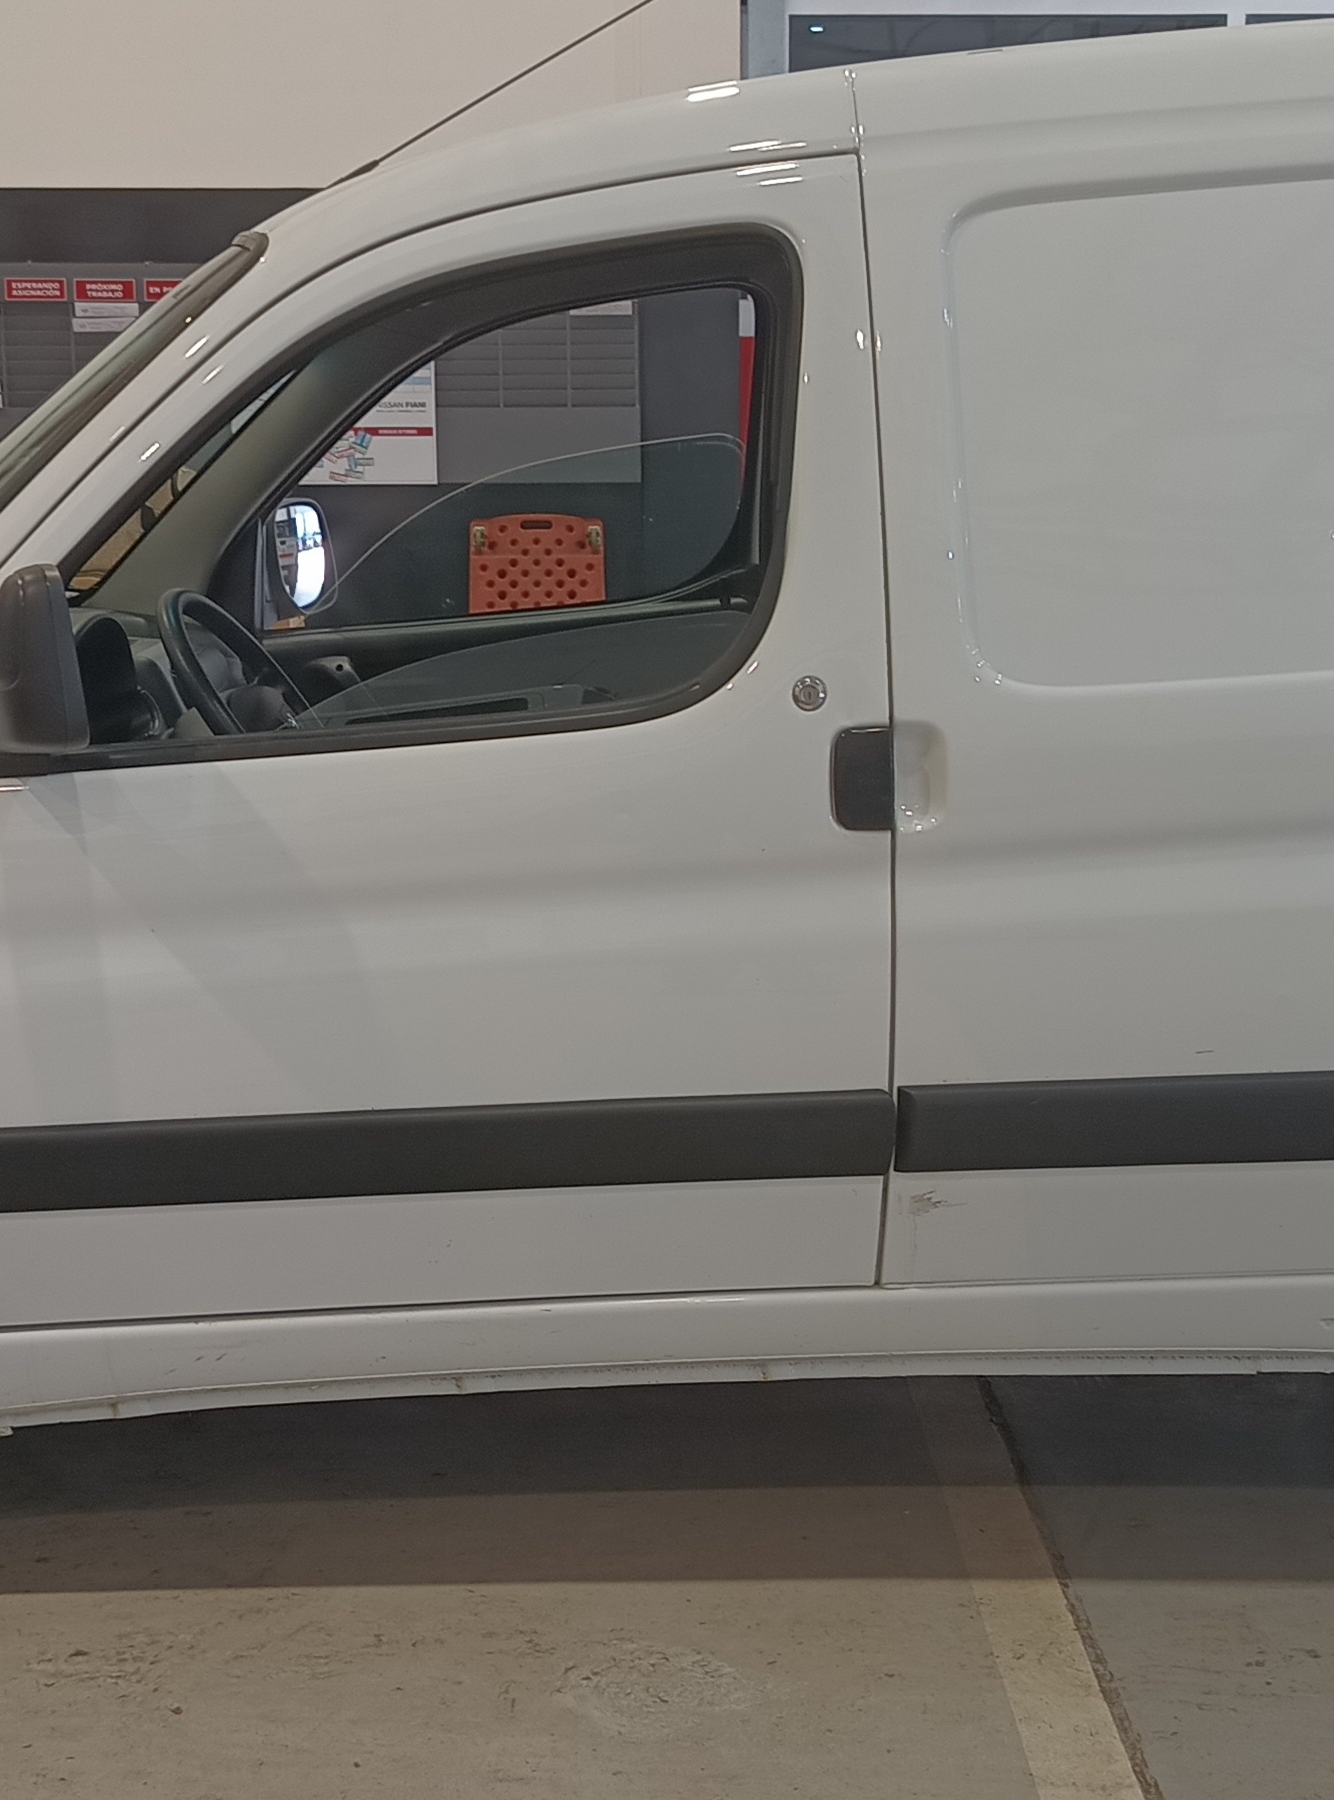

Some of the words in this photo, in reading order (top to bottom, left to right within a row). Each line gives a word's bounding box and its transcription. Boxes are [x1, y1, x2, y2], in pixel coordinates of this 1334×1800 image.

[11, 282, 61, 290] ESPERANDO
[148, 286, 161, 294] EN
[87, 291, 124, 299] TRABAJO
